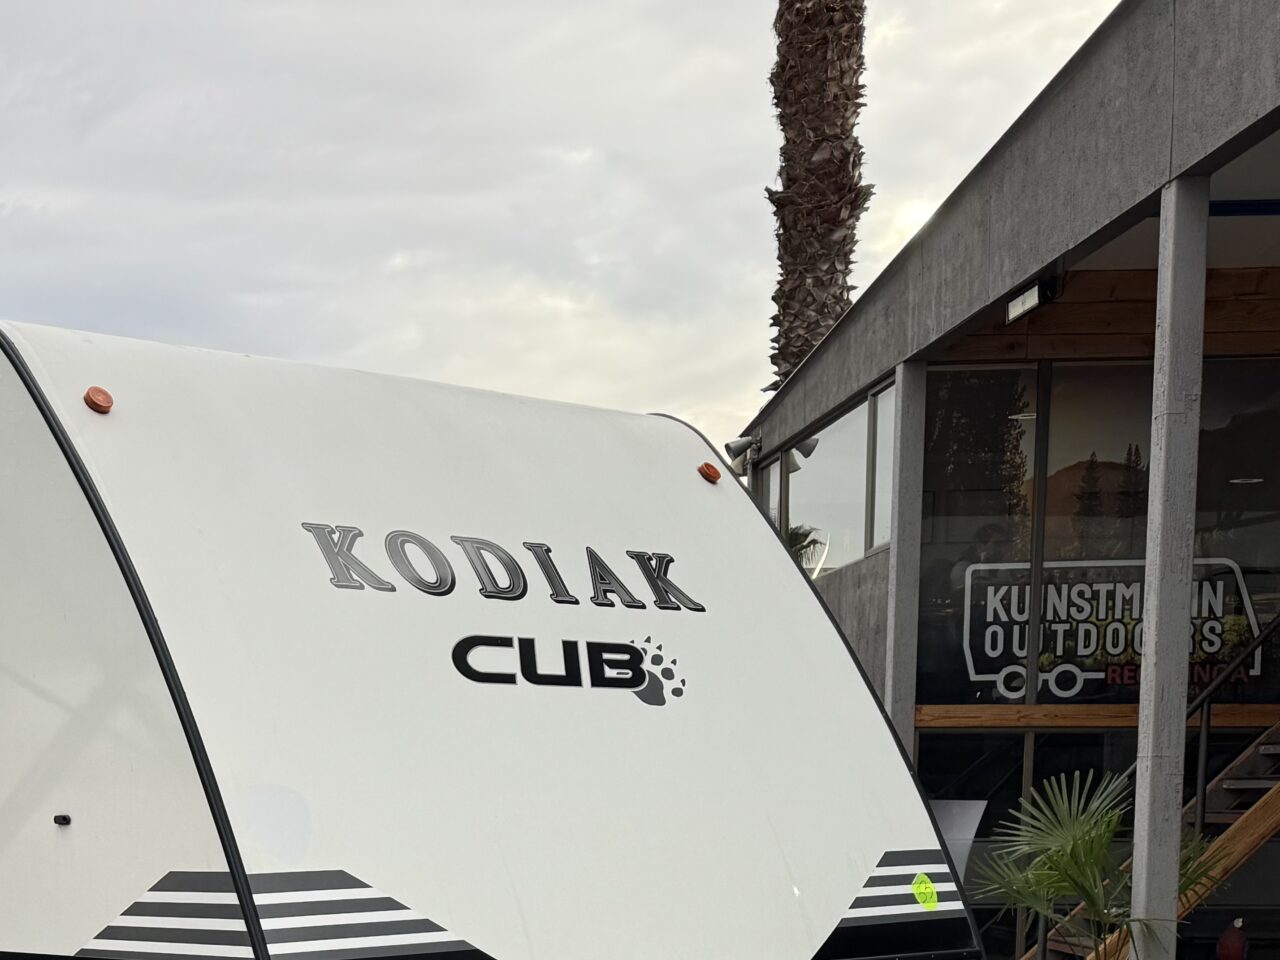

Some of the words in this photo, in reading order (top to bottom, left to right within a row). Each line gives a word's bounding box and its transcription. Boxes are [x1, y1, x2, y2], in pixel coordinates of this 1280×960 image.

[301, 522, 706, 612] KODIAK
[986, 580, 1224, 622] KUNSTMN
[451, 634, 648, 690] CUB
[984, 619, 1223, 657] OUTDOS
